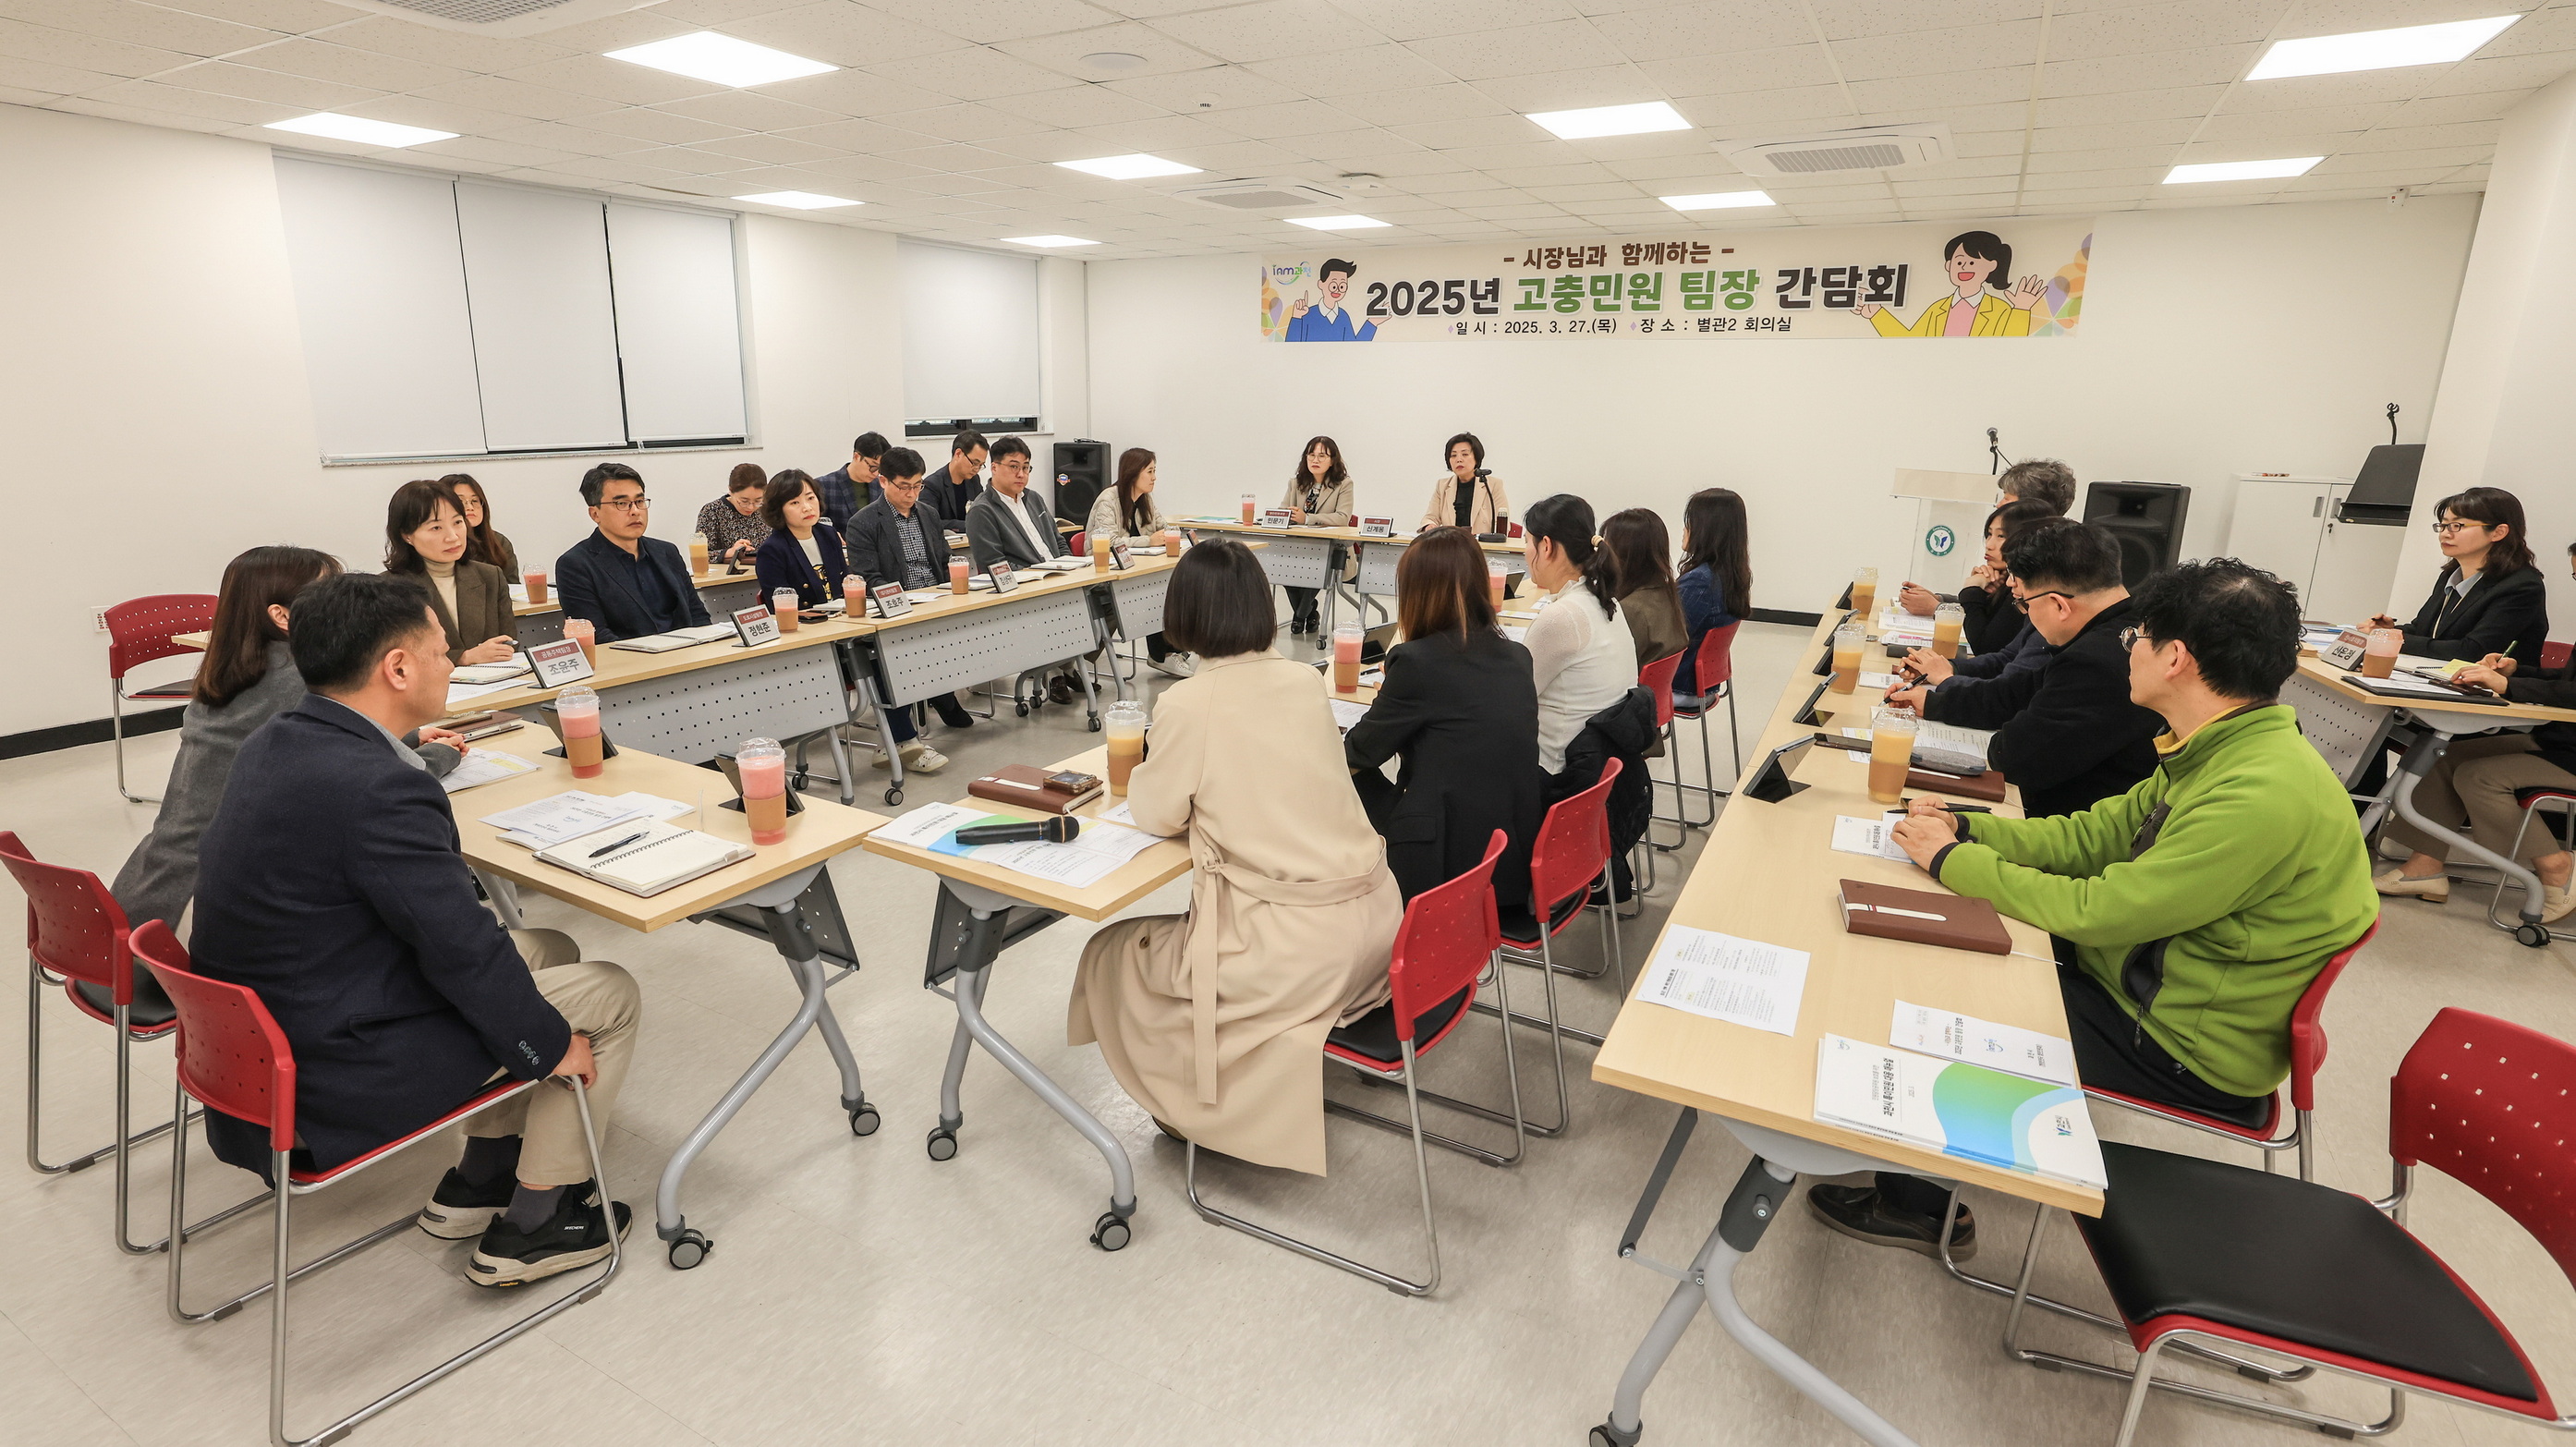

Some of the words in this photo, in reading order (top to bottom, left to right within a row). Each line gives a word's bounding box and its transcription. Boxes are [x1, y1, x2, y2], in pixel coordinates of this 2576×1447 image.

[1524, 244, 1607, 269] 시장님과
[1622, 241, 1711, 266] 함께하는
[1366, 276, 1501, 315] 2025년
[1513, 272, 1664, 313] 고충민원
[1680, 269, 1760, 310] 팀장
[1776, 263, 1909, 310] 간담회
[1504, 321, 1543, 334] 2025.
[1549, 321, 1561, 334] 3.
[1569, 318, 1617, 334] 27.(목)
[1697, 317, 1737, 332] 별관2
[1744, 316, 1792, 333] 회의실
[541, 646, 572, 659] 공동주택팀장
[2331, 646, 2356, 661] 신은정
[547, 658, 579, 675] 조윤주
